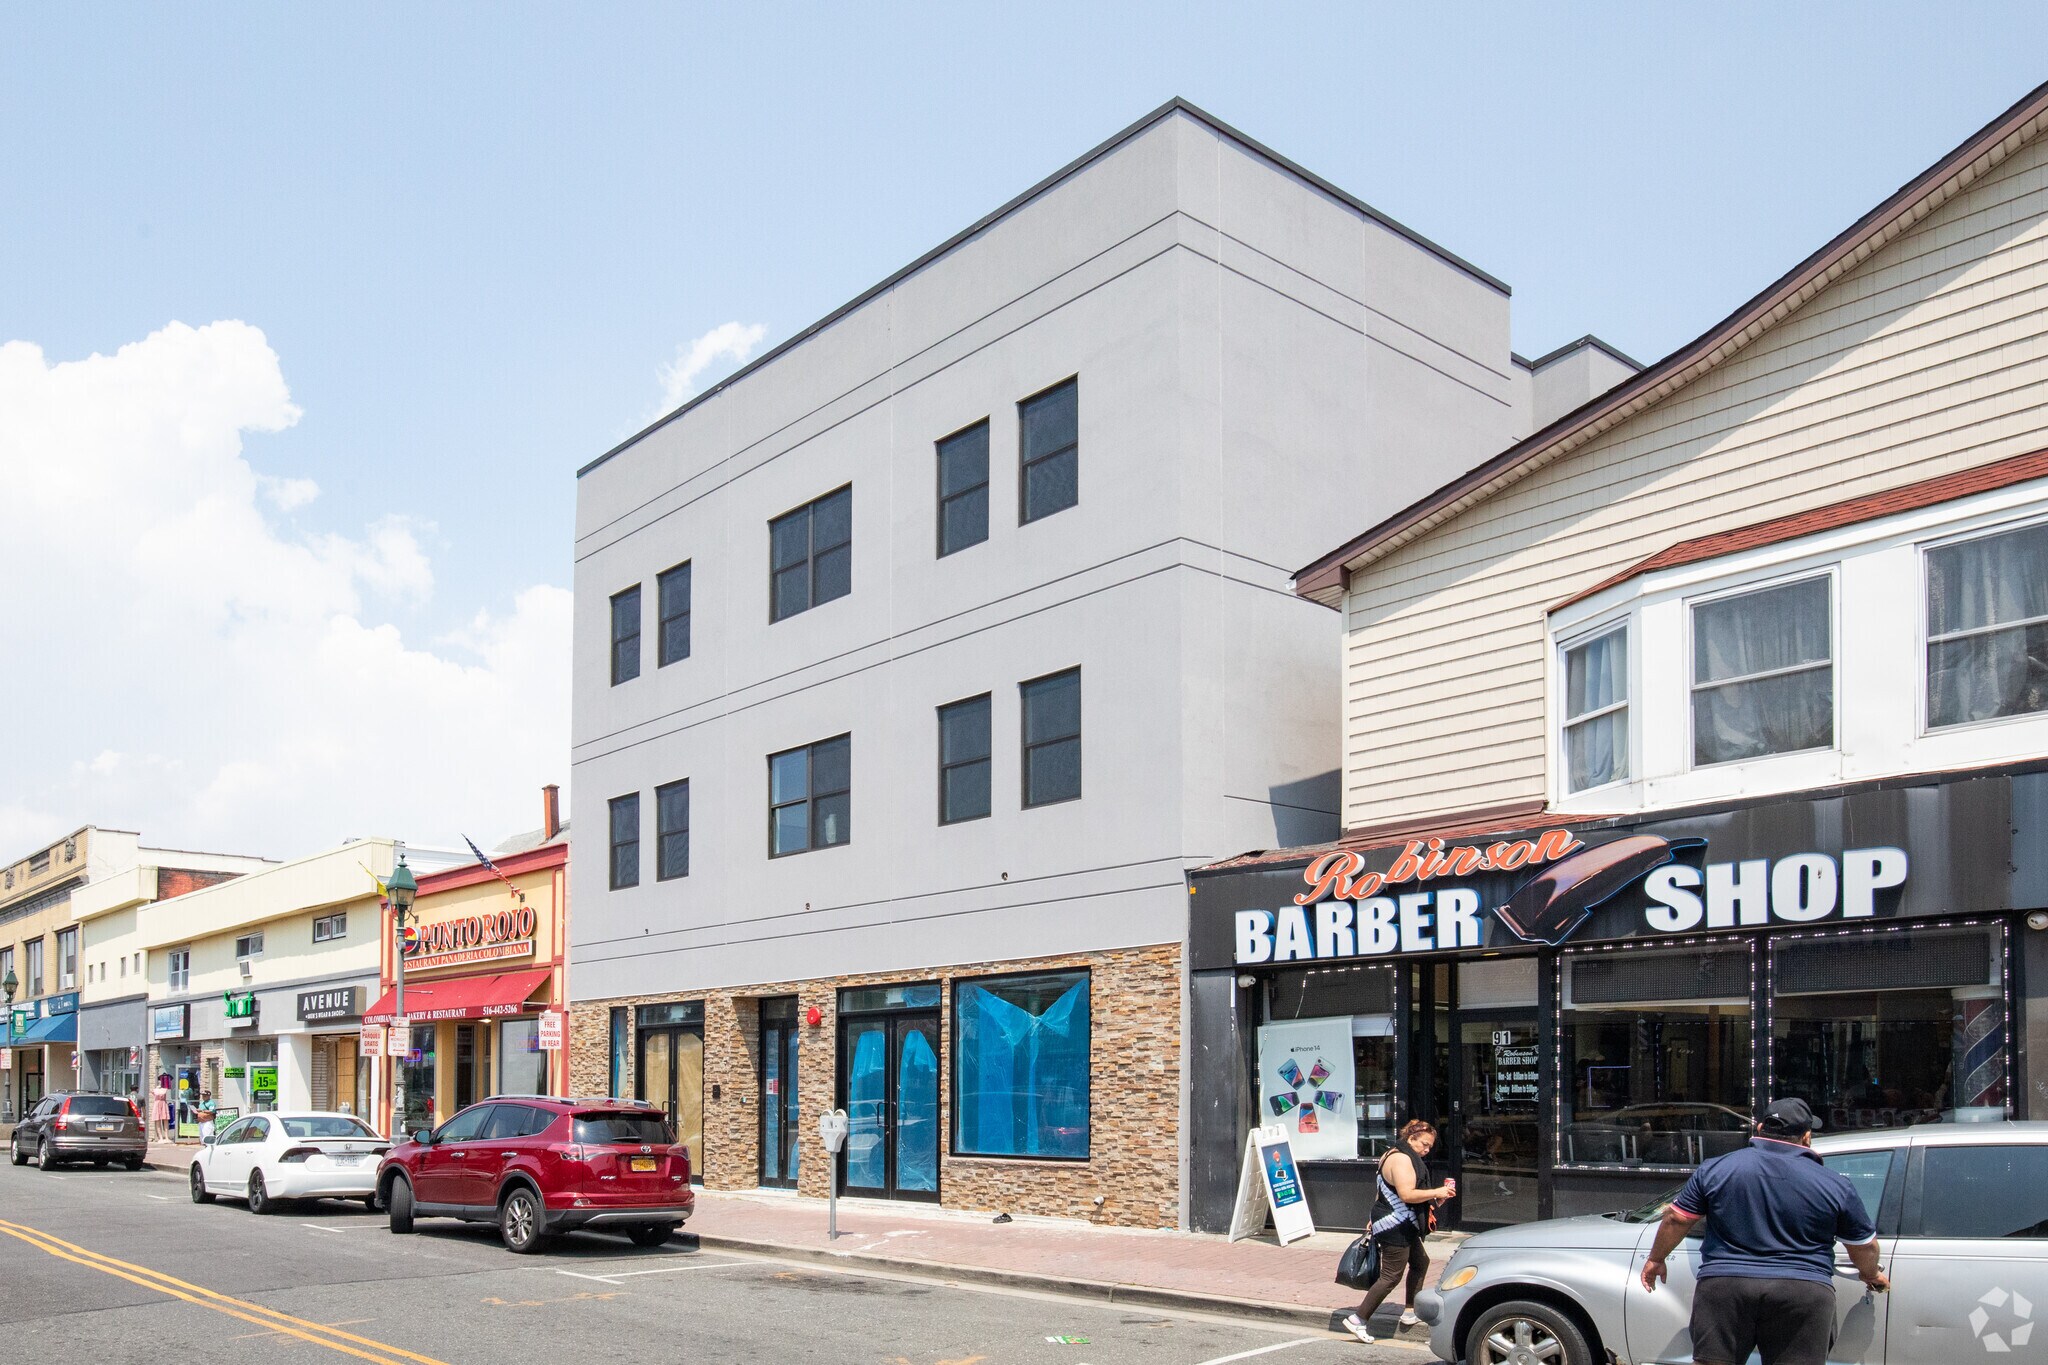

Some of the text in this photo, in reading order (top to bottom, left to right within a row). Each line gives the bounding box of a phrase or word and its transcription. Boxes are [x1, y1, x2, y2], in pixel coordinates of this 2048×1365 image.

[1294, 829, 1584, 905] Robinson
[1235, 846, 1908, 964] BARBER SHOP
[418, 906, 534, 953] PUNTO ROJO
[441, 951, 478, 964] PANADERIA
[479, 944, 528, 959] COLOMBIANA
[303, 991, 349, 1011] AVENUE
[427, 1010, 432, 1019] &
[433, 1008, 467, 1019] RESTAURANT
[1494, 1031, 1509, 1044] 91
[1498, 1056, 1538, 1066] BARBER SHOP
